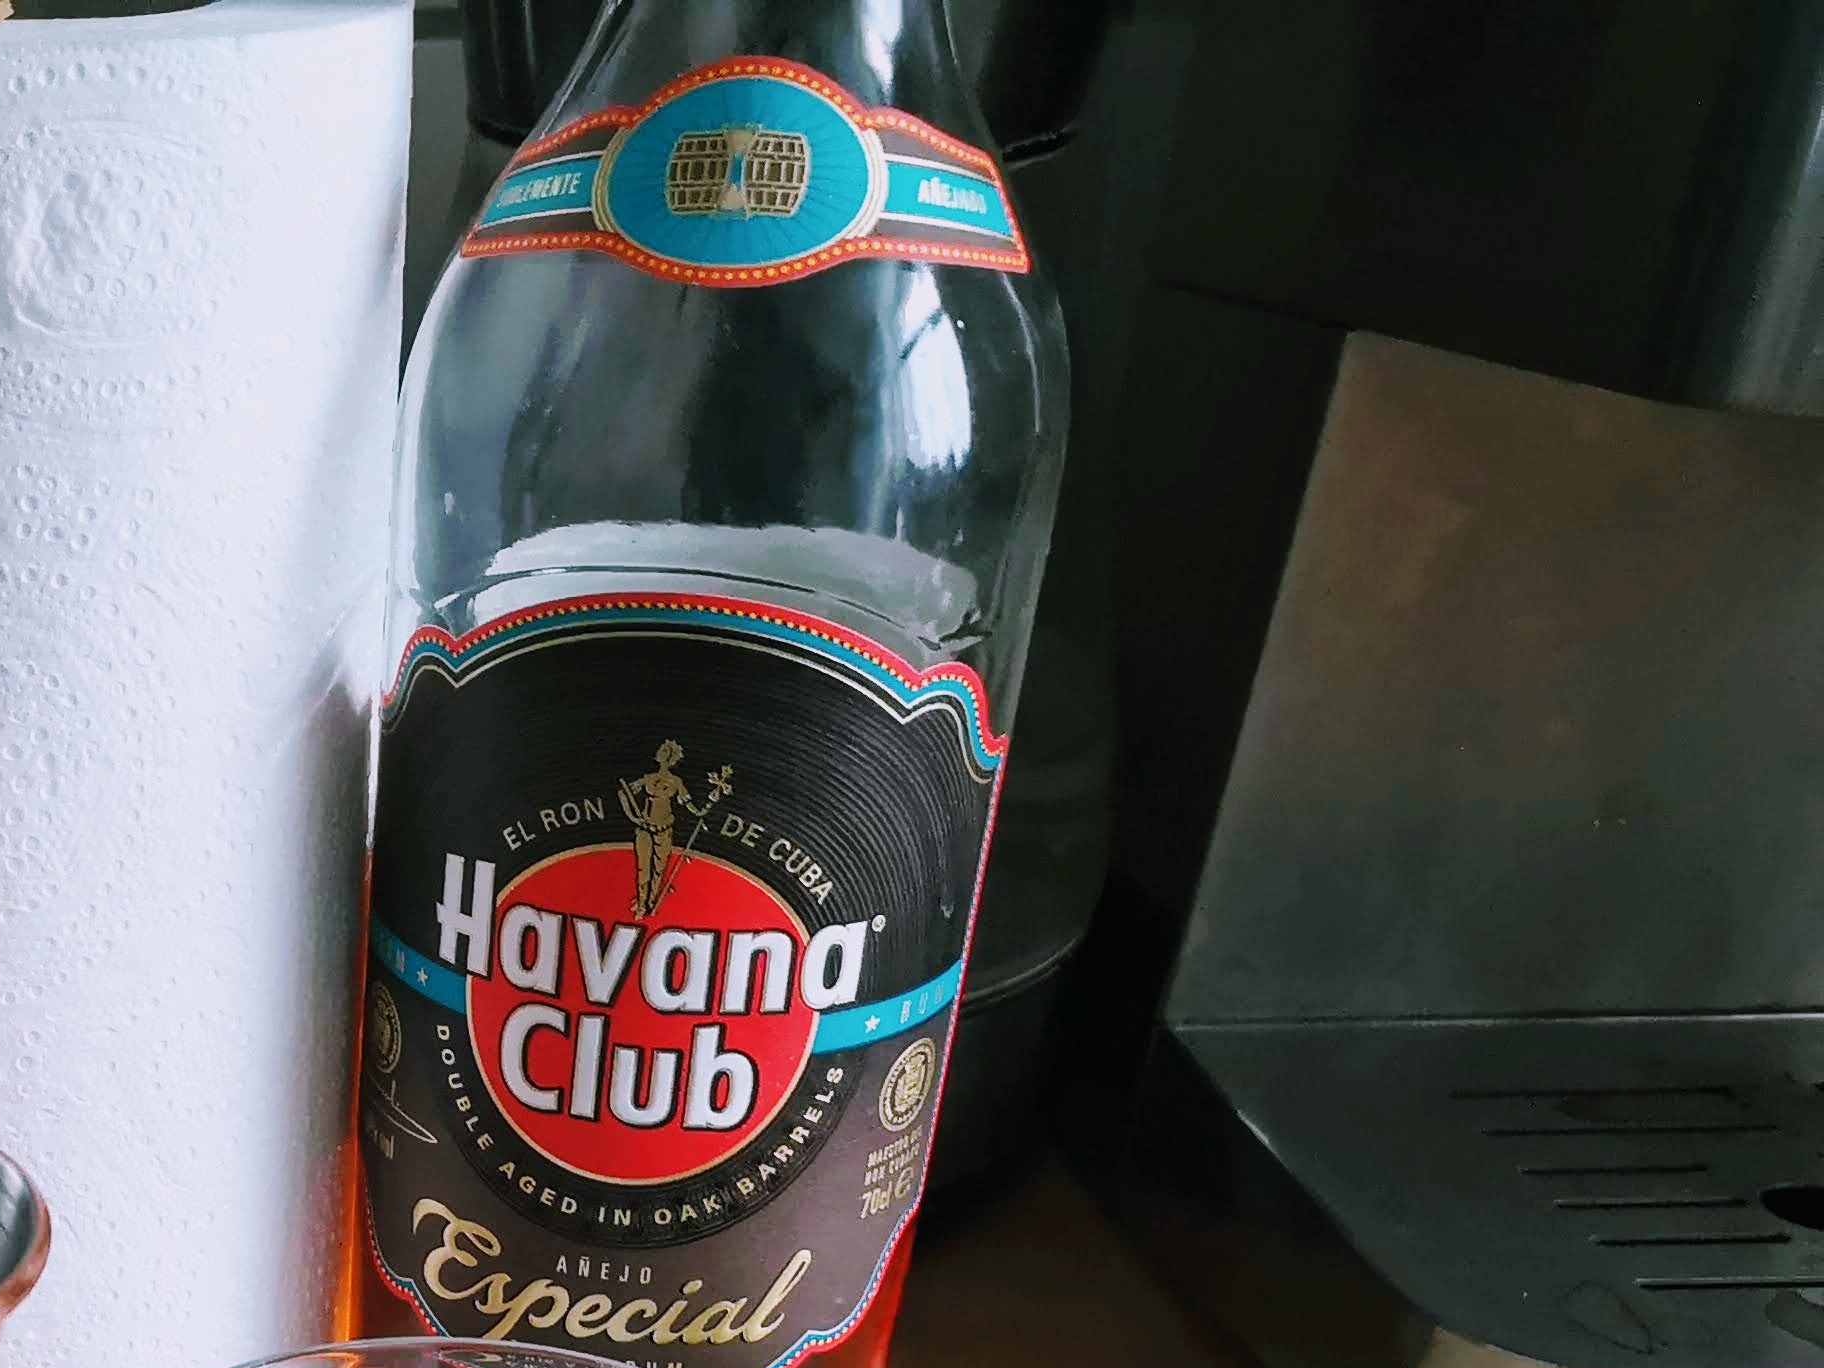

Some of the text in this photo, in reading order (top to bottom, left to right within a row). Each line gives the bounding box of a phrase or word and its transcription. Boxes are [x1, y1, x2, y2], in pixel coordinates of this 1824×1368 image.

[502, 797, 837, 905] EL RON DE CUBA
[436, 853, 868, 1014] Havana
[436, 1025, 494, 1151] DOUBLE
[498, 1161, 578, 1215] AGED
[598, 1205, 631, 1227] IN
[654, 1194, 722, 1226] OAK
[735, 1066, 844, 1197] BARRELS
[500, 1003, 755, 1130] Club
[412, 1198, 813, 1345] Especial
[556, 1255, 652, 1285] AÑEJO
